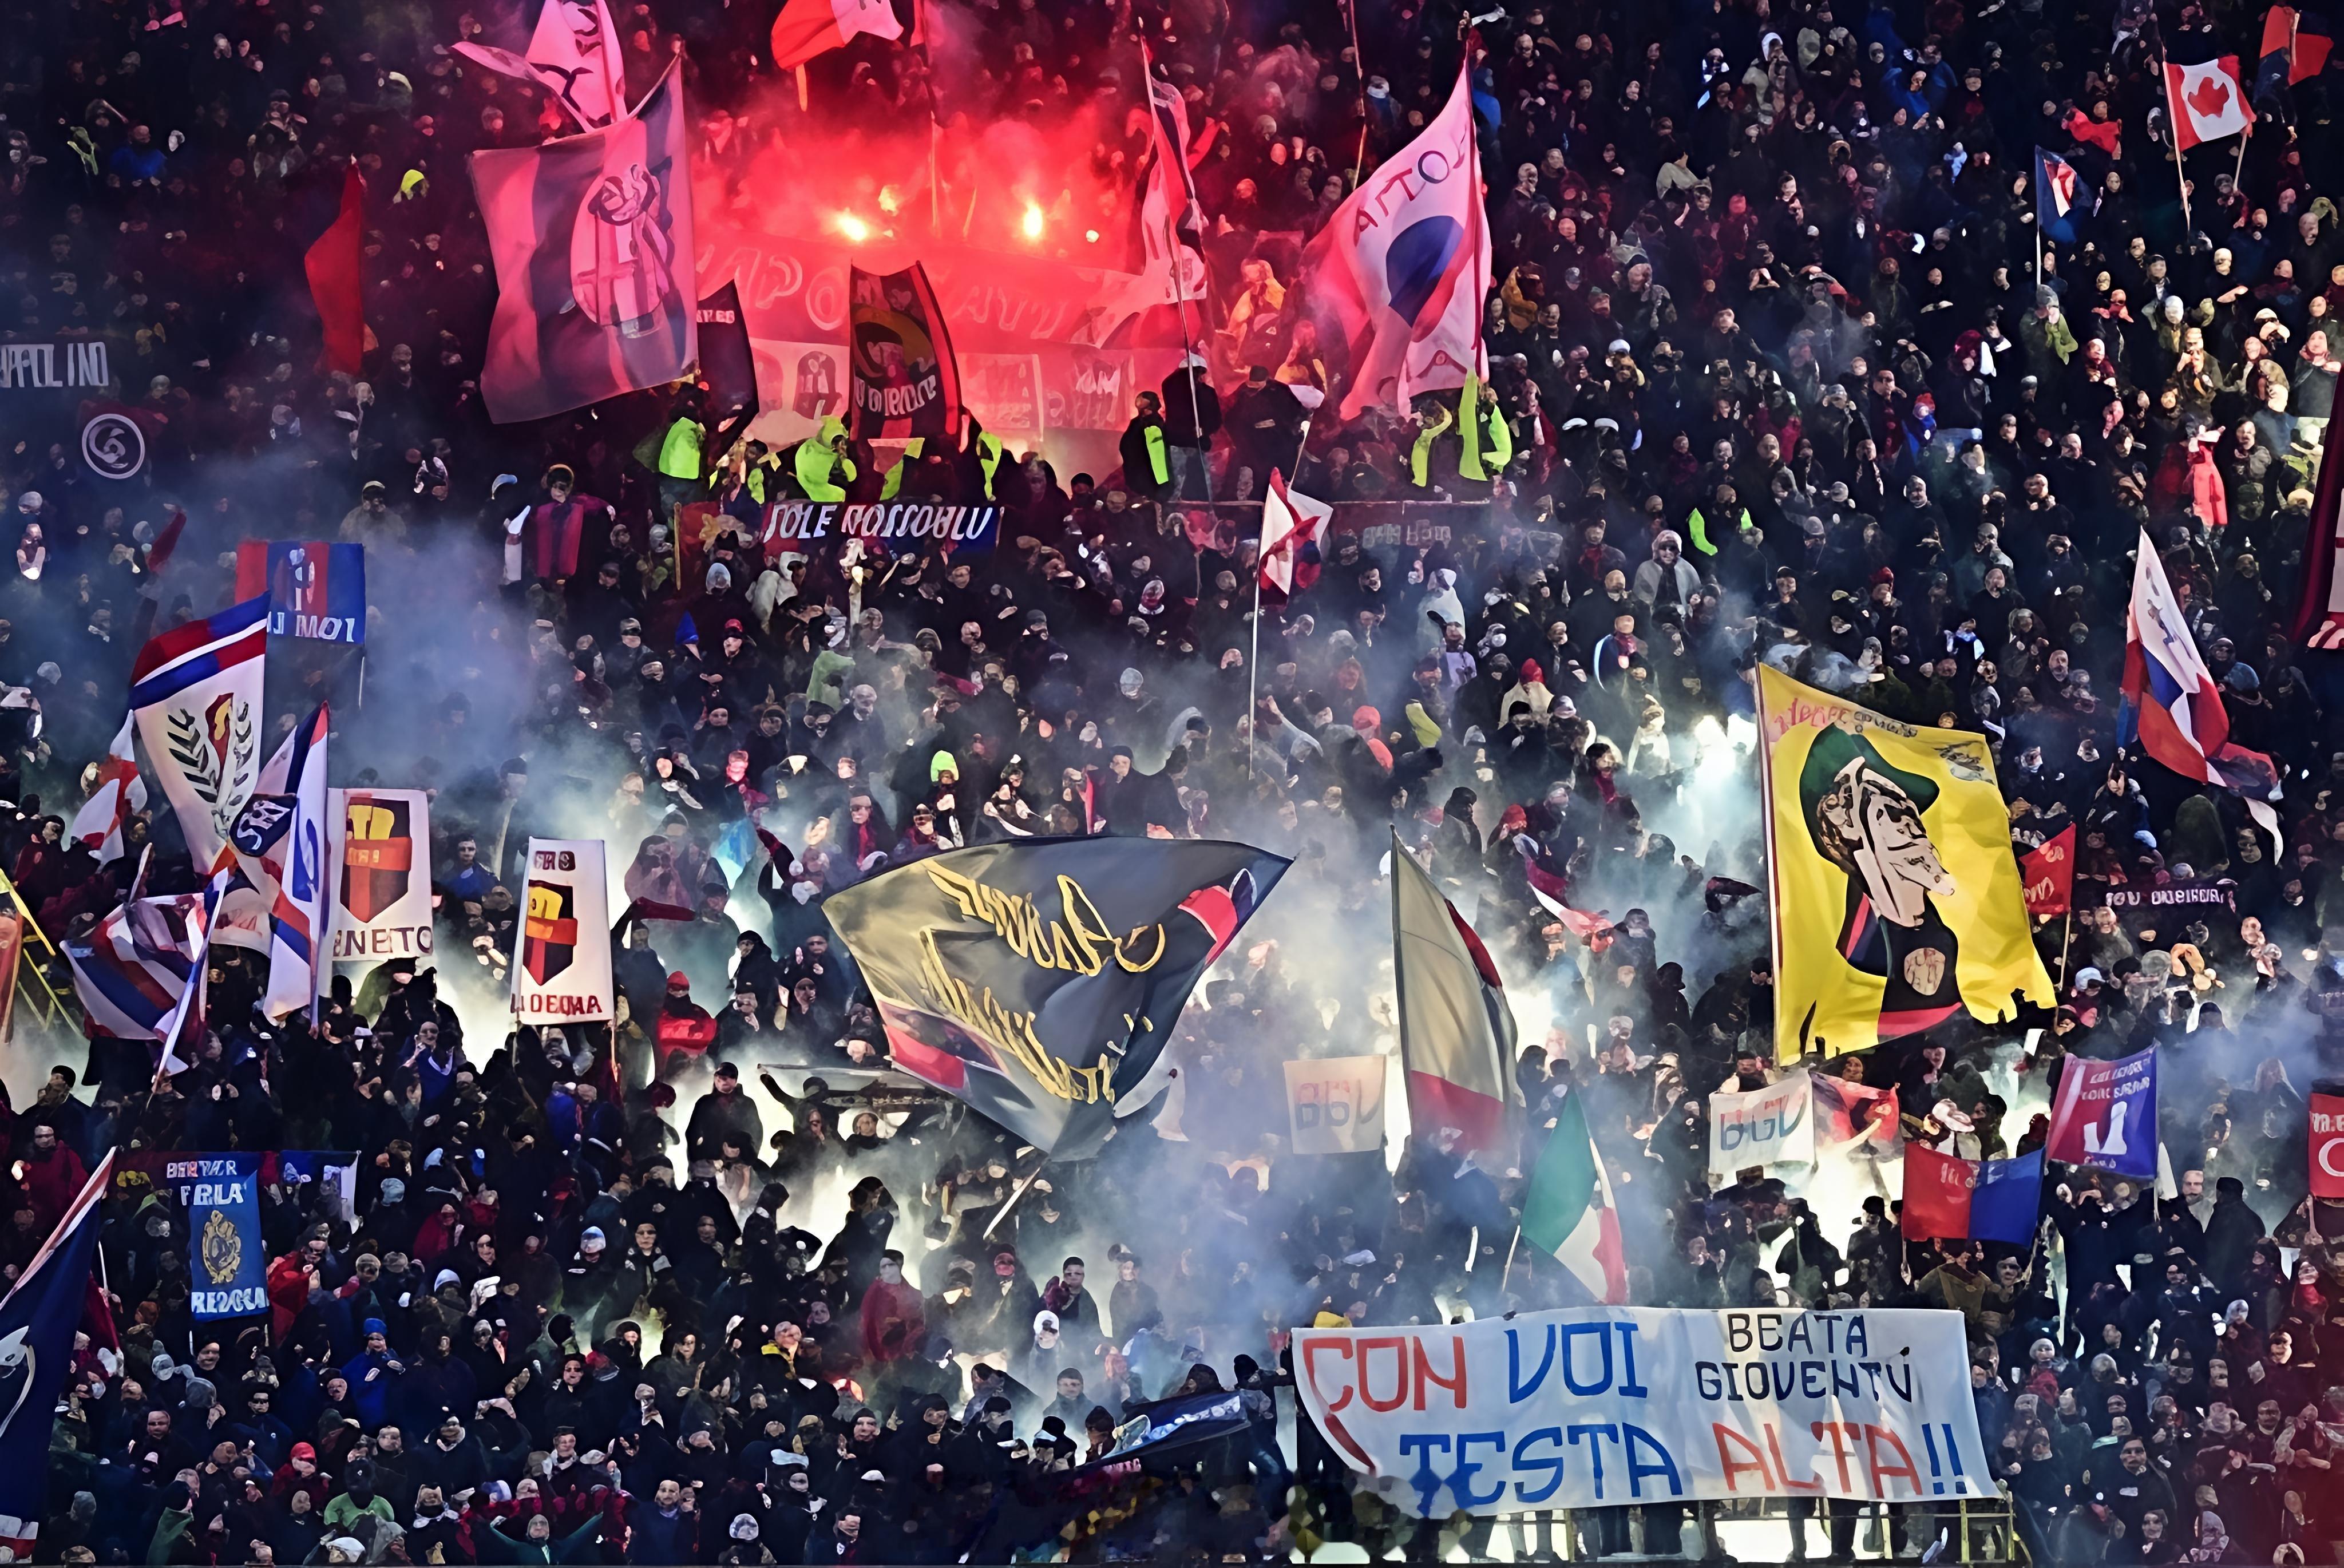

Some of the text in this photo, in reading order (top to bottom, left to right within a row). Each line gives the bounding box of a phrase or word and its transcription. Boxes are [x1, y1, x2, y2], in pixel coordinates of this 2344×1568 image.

[1302, 1321, 1648, 1415] CON VOI
[1727, 1313, 1868, 1357] BEATA
[1399, 1420, 1967, 1517] TESTA ALTA!!
